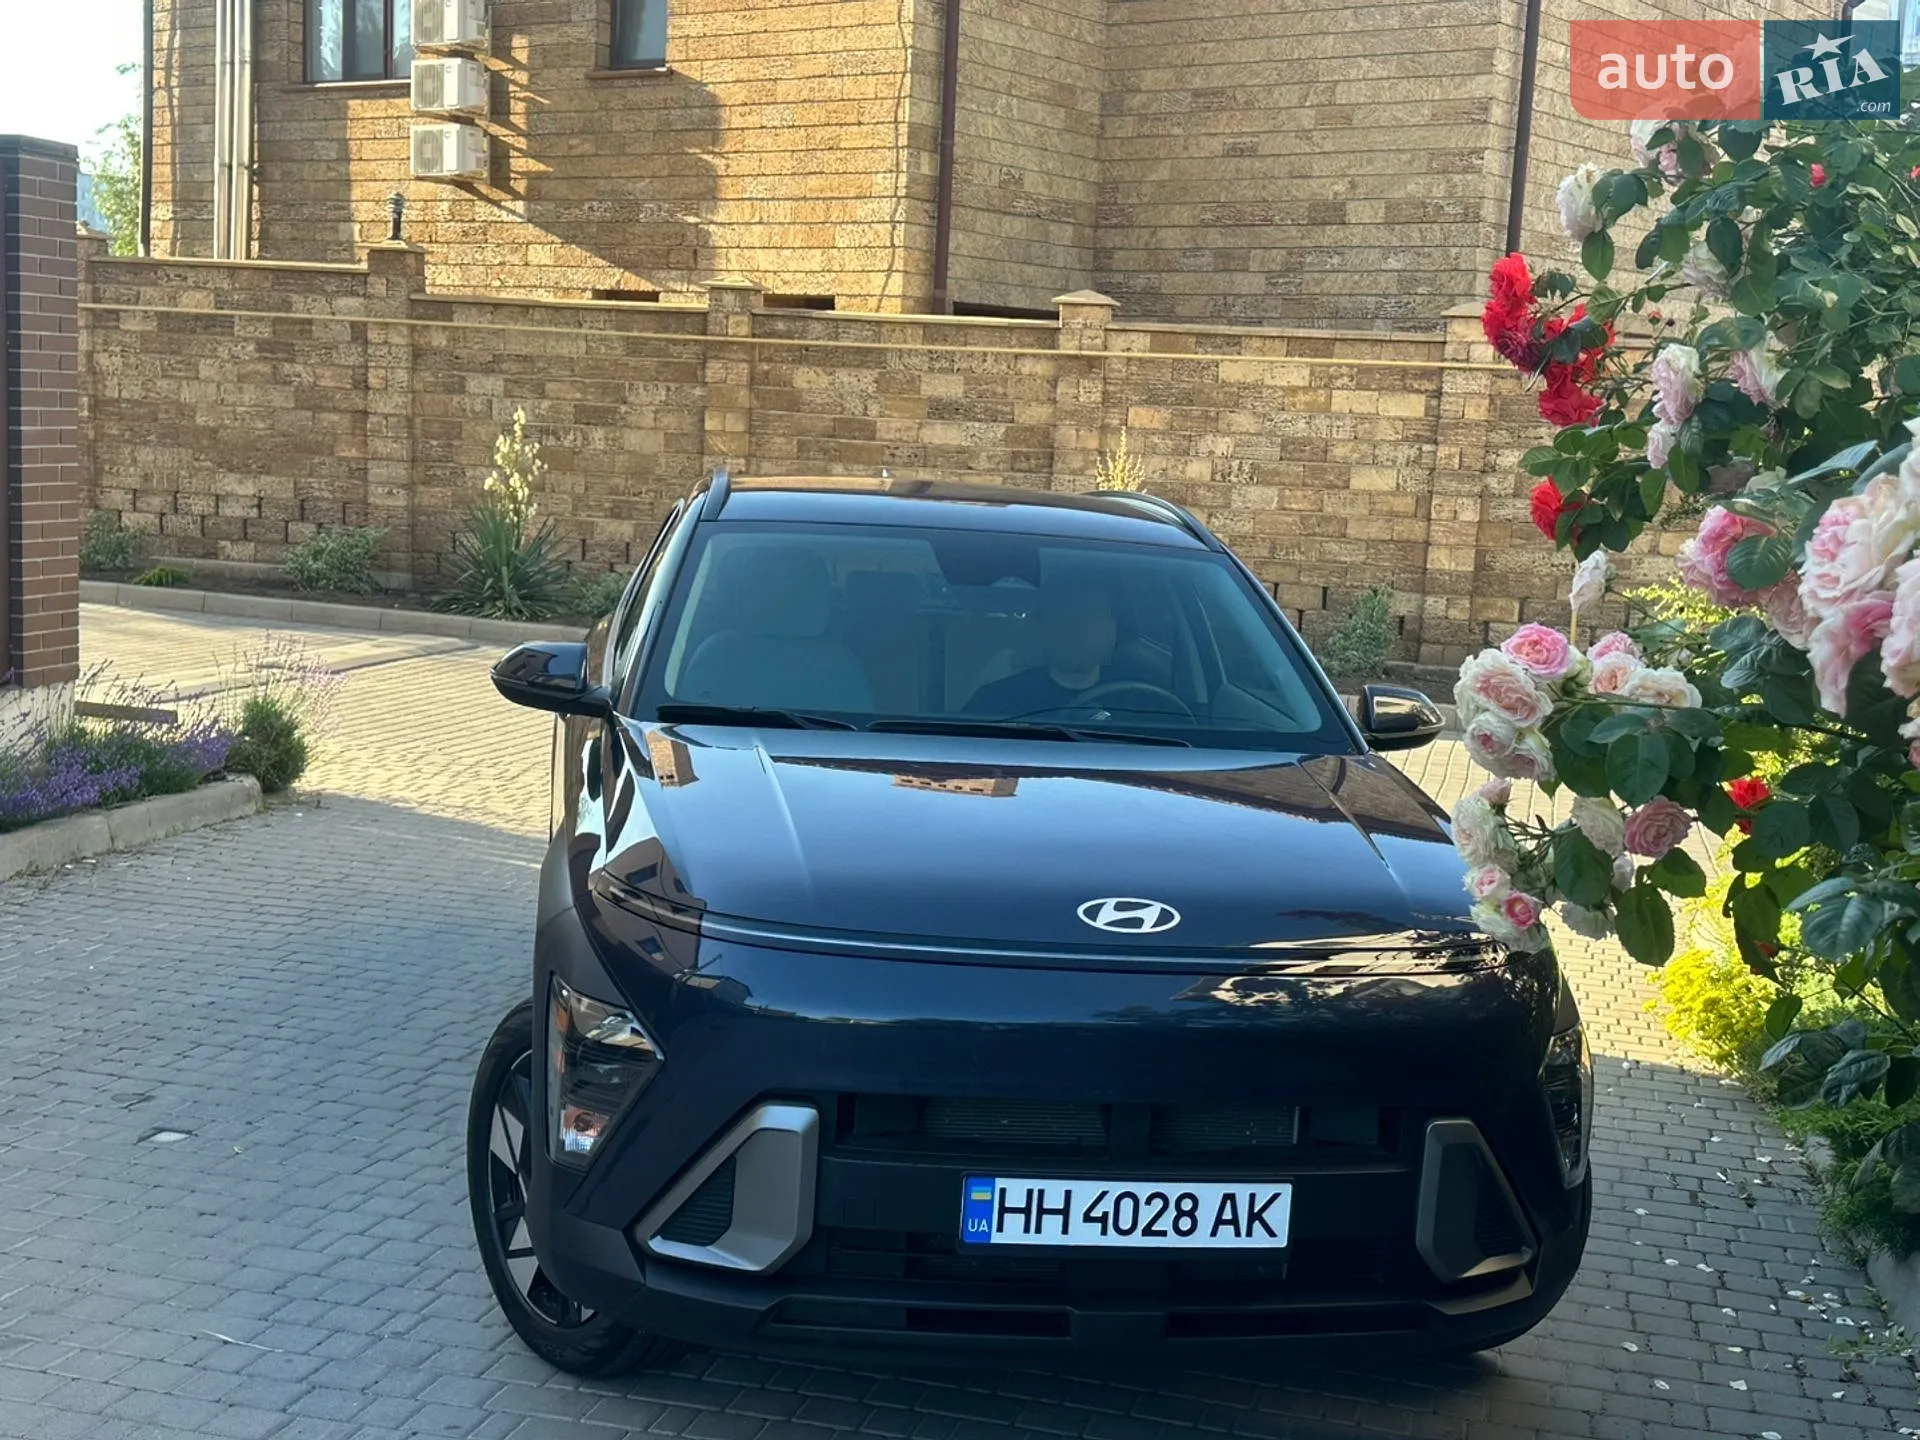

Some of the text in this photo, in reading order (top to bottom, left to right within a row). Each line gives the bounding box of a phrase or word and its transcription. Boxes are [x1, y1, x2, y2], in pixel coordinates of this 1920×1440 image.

[967, 1218, 989, 1233] UA
[996, 1187, 1282, 1238] HH 4028 AK
